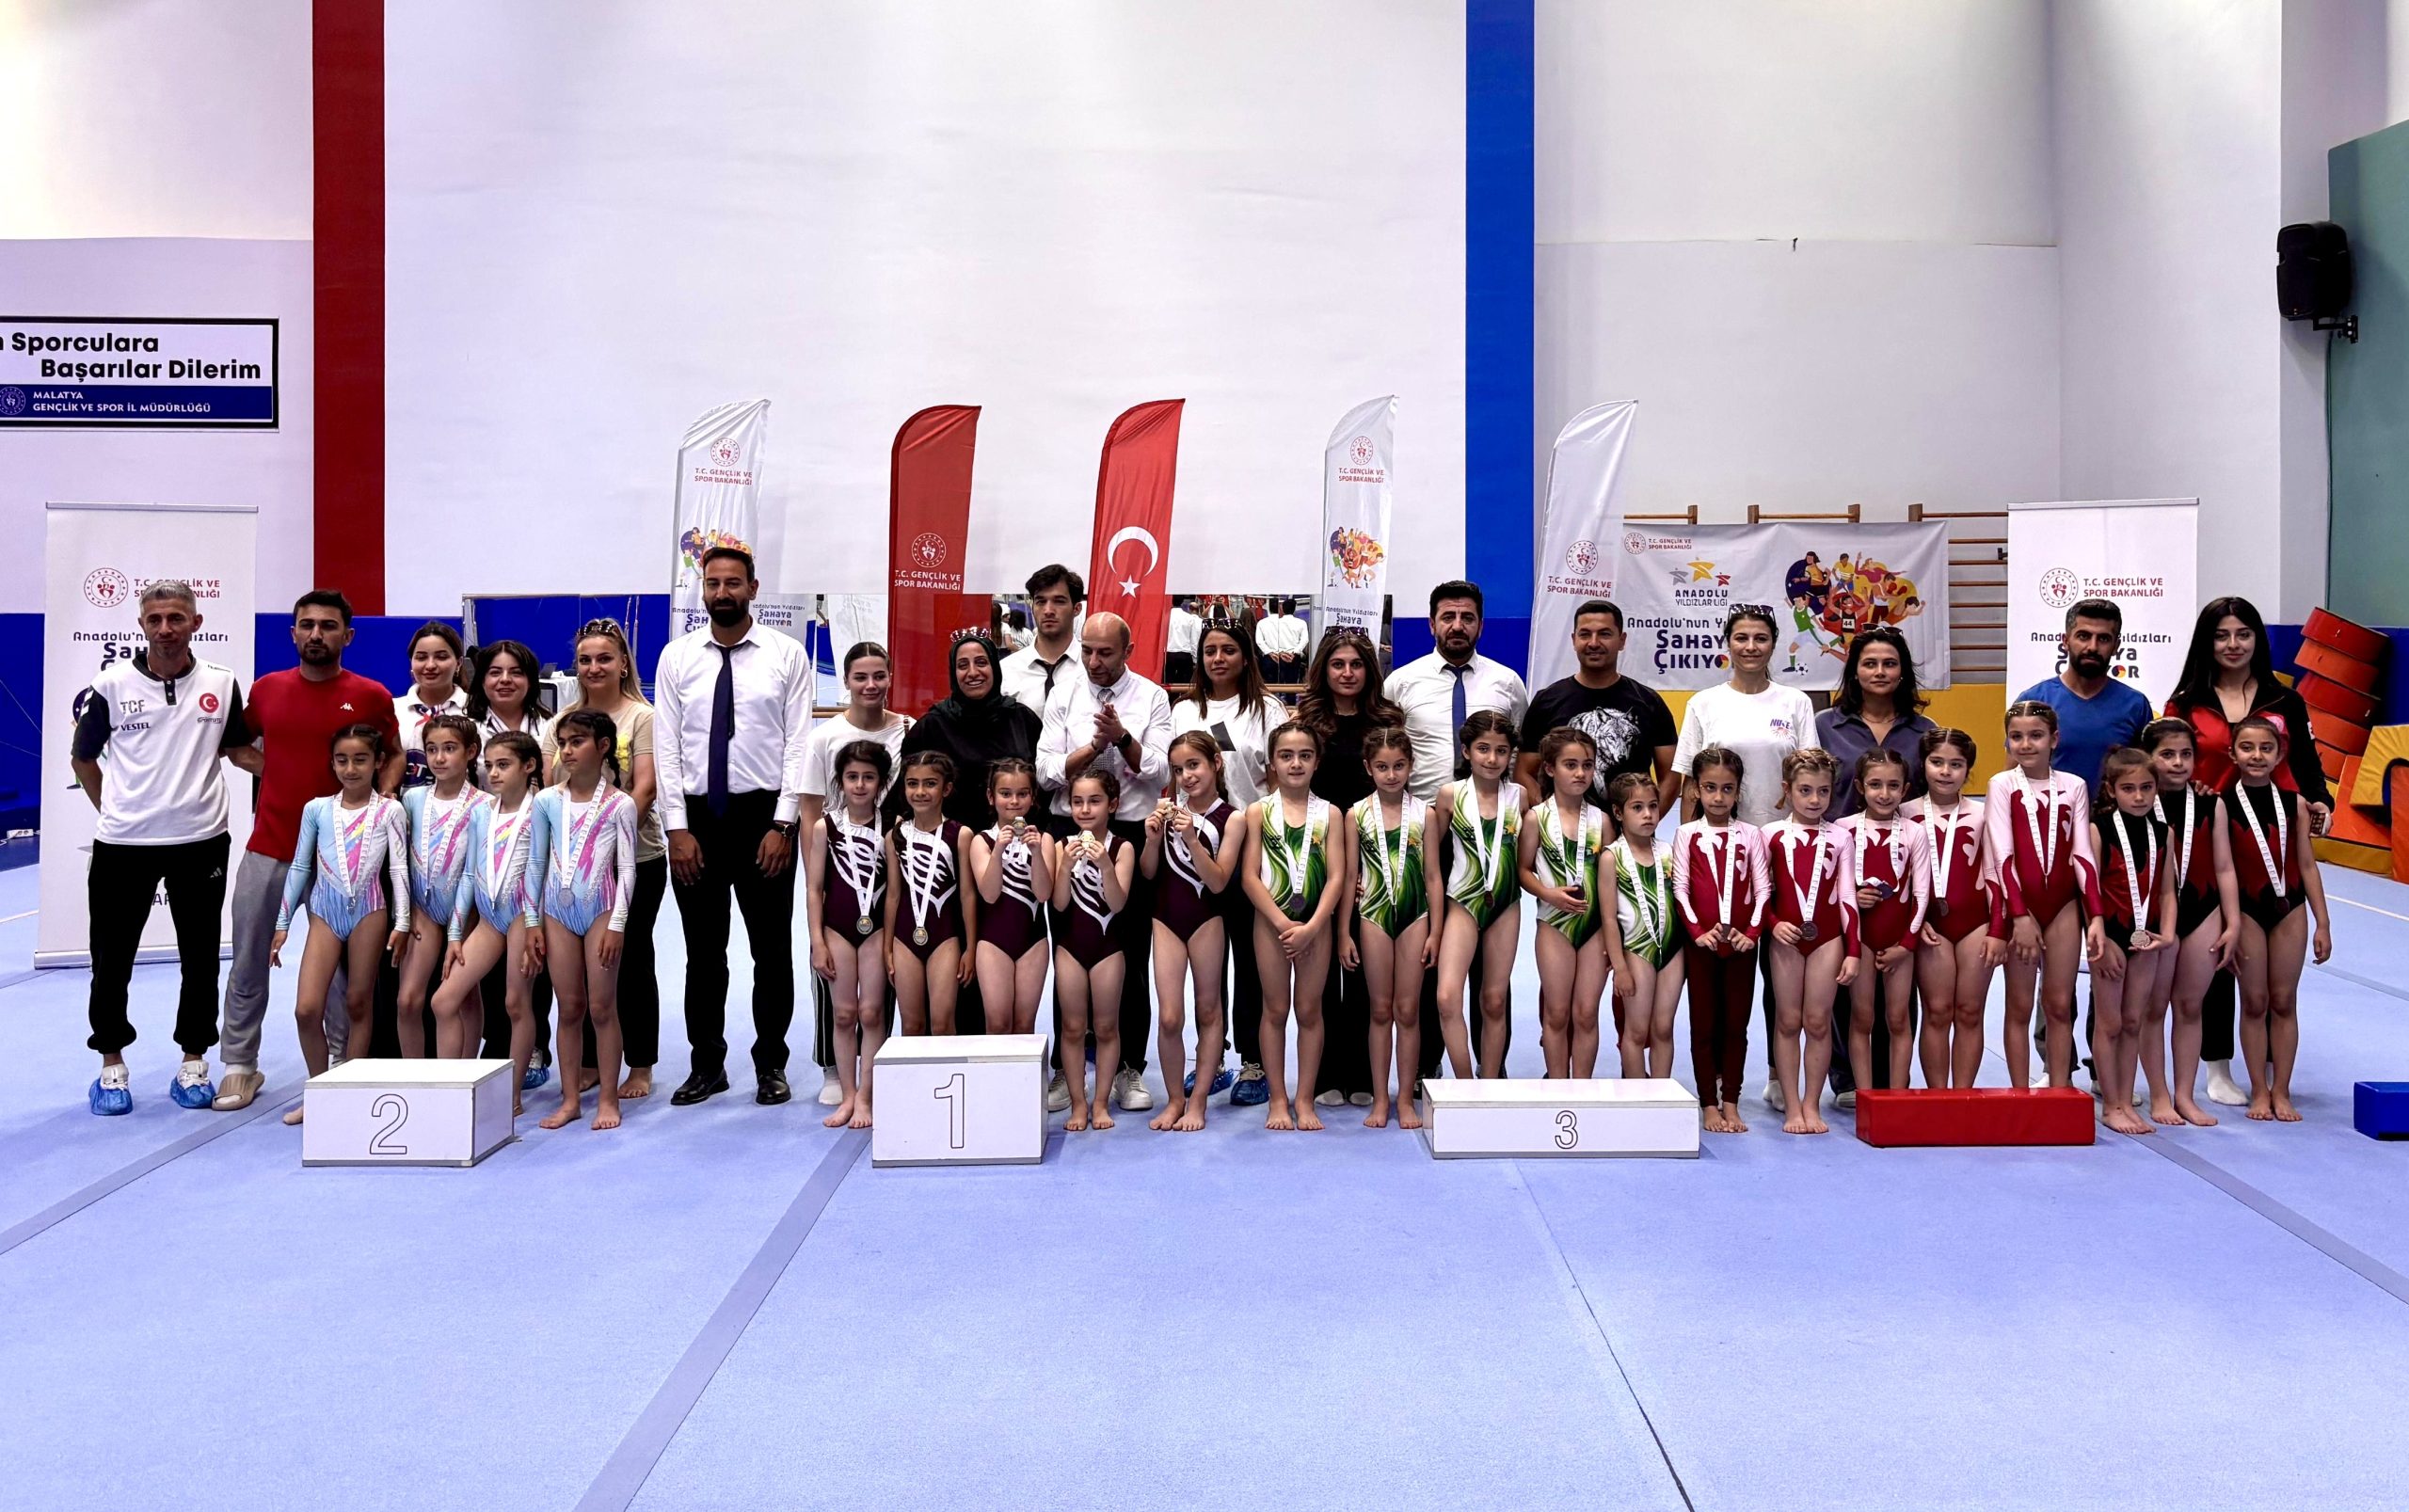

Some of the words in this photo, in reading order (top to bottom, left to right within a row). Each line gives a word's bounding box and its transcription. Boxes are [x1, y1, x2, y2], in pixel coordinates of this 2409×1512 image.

[11, 332, 159, 356] Sporculara
[41, 358, 163, 383] Başarılar
[168, 359, 261, 379] Dilerim
[33, 390, 84, 400] MALATYA
[33, 402, 79, 414] GENÇLİK
[81, 404, 94, 412] VE
[97, 404, 124, 412] SPOR
[127, 402, 137, 412] İL
[139, 402, 211, 412] MÜDÜRLÜĞÜ
[895, 569, 909, 578] T.C.
[911, 570, 948, 581] GENÇLİK
[134, 579, 152, 587] T.C
[207, 580, 220, 588] VE
[917, 581, 961, 591] BAKANLIĞI
[1548, 576, 1562, 584] T.C.
[1565, 577, 1599, 589] GENÇLİK
[1601, 581, 1612, 589] VE
[2083, 578, 2101, 587] T.C.
[2103, 577, 2146, 588] GENÇLİK
[2149, 578, 2163, 586] VE
[1547, 585, 1569, 594] SPOR
[1570, 587, 1611, 598] BAKANLIĞI
[1675, 589, 1728, 597] ANADOLU
[2083, 589, 2109, 597] SPOR
[2111, 587, 2163, 597] BAKANLIĞI
[1675, 598, 1713, 607] YILDIZLAR
[1627, 617, 1710, 629] Anadolu'nun
[2118, 632, 2171, 643] ıldızları
[120, 699, 145, 715] TCF
[120, 722, 152, 731] VESTEL
[933, 1074, 965, 1149] 1
[370, 1093, 408, 1154] 2
[1554, 1109, 1578, 1150] 3
